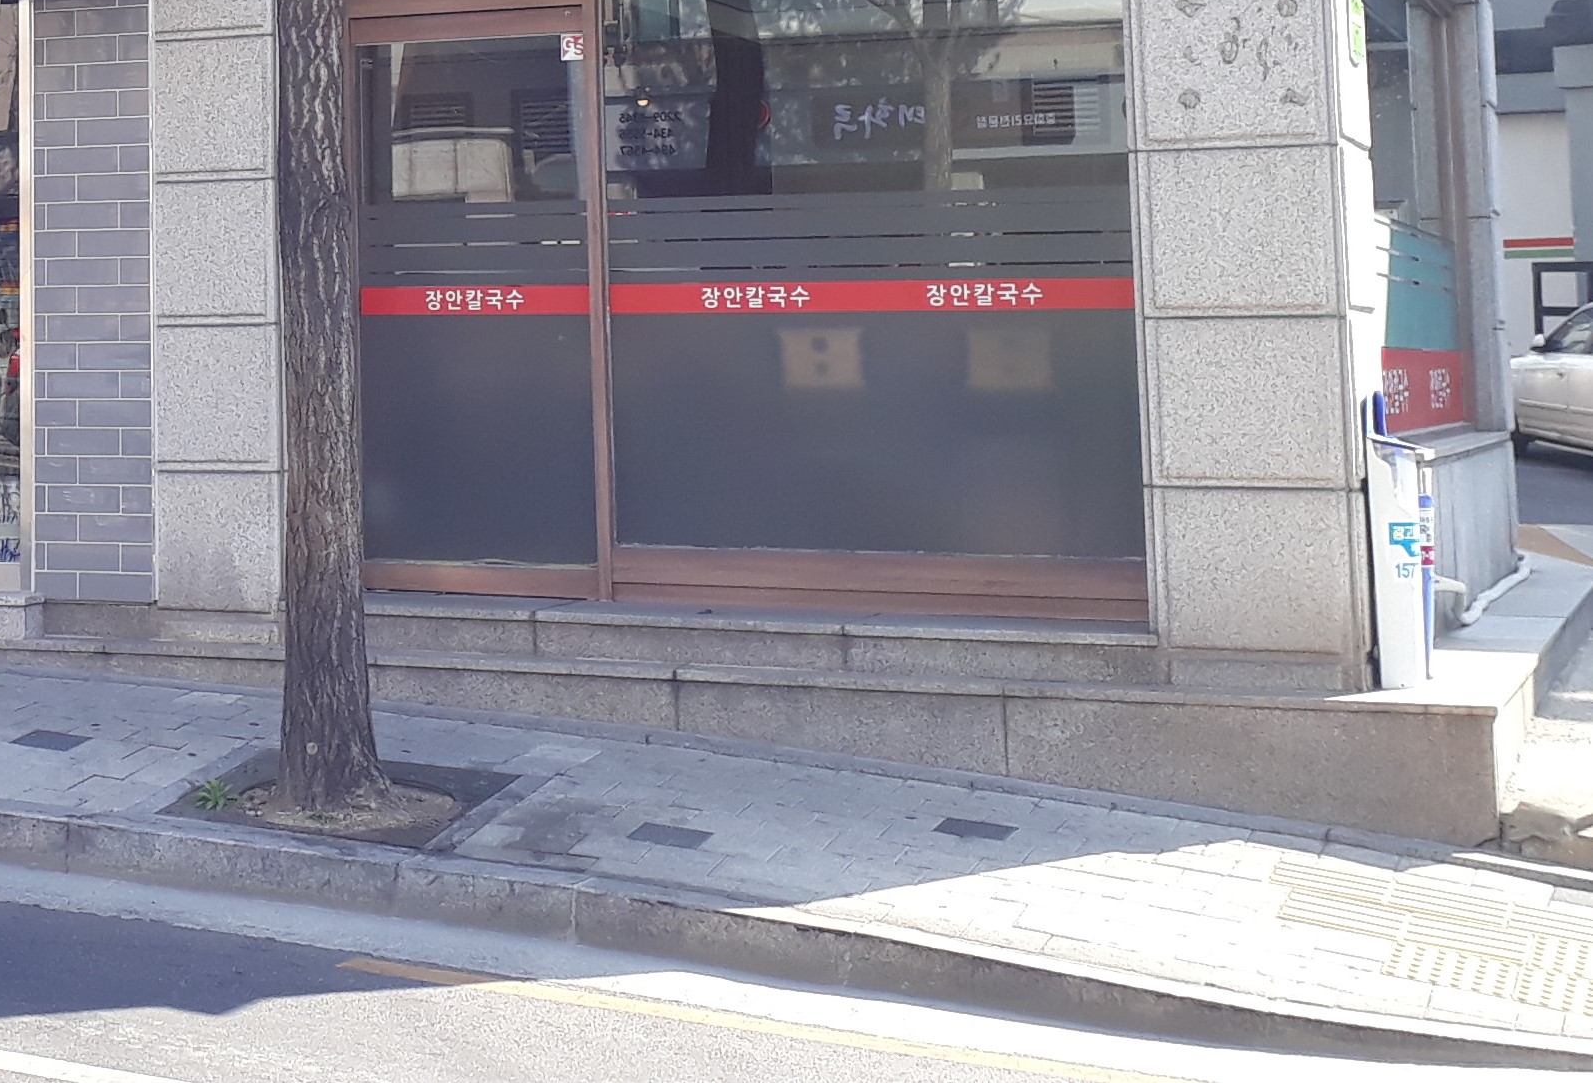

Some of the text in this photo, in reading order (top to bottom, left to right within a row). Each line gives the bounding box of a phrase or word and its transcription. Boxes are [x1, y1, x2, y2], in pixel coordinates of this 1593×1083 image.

[425, 290, 525, 311] 장안칼국수
[701, 285, 811, 309] 장안칼국수
[925, 282, 1044, 307] 장안칼국수
